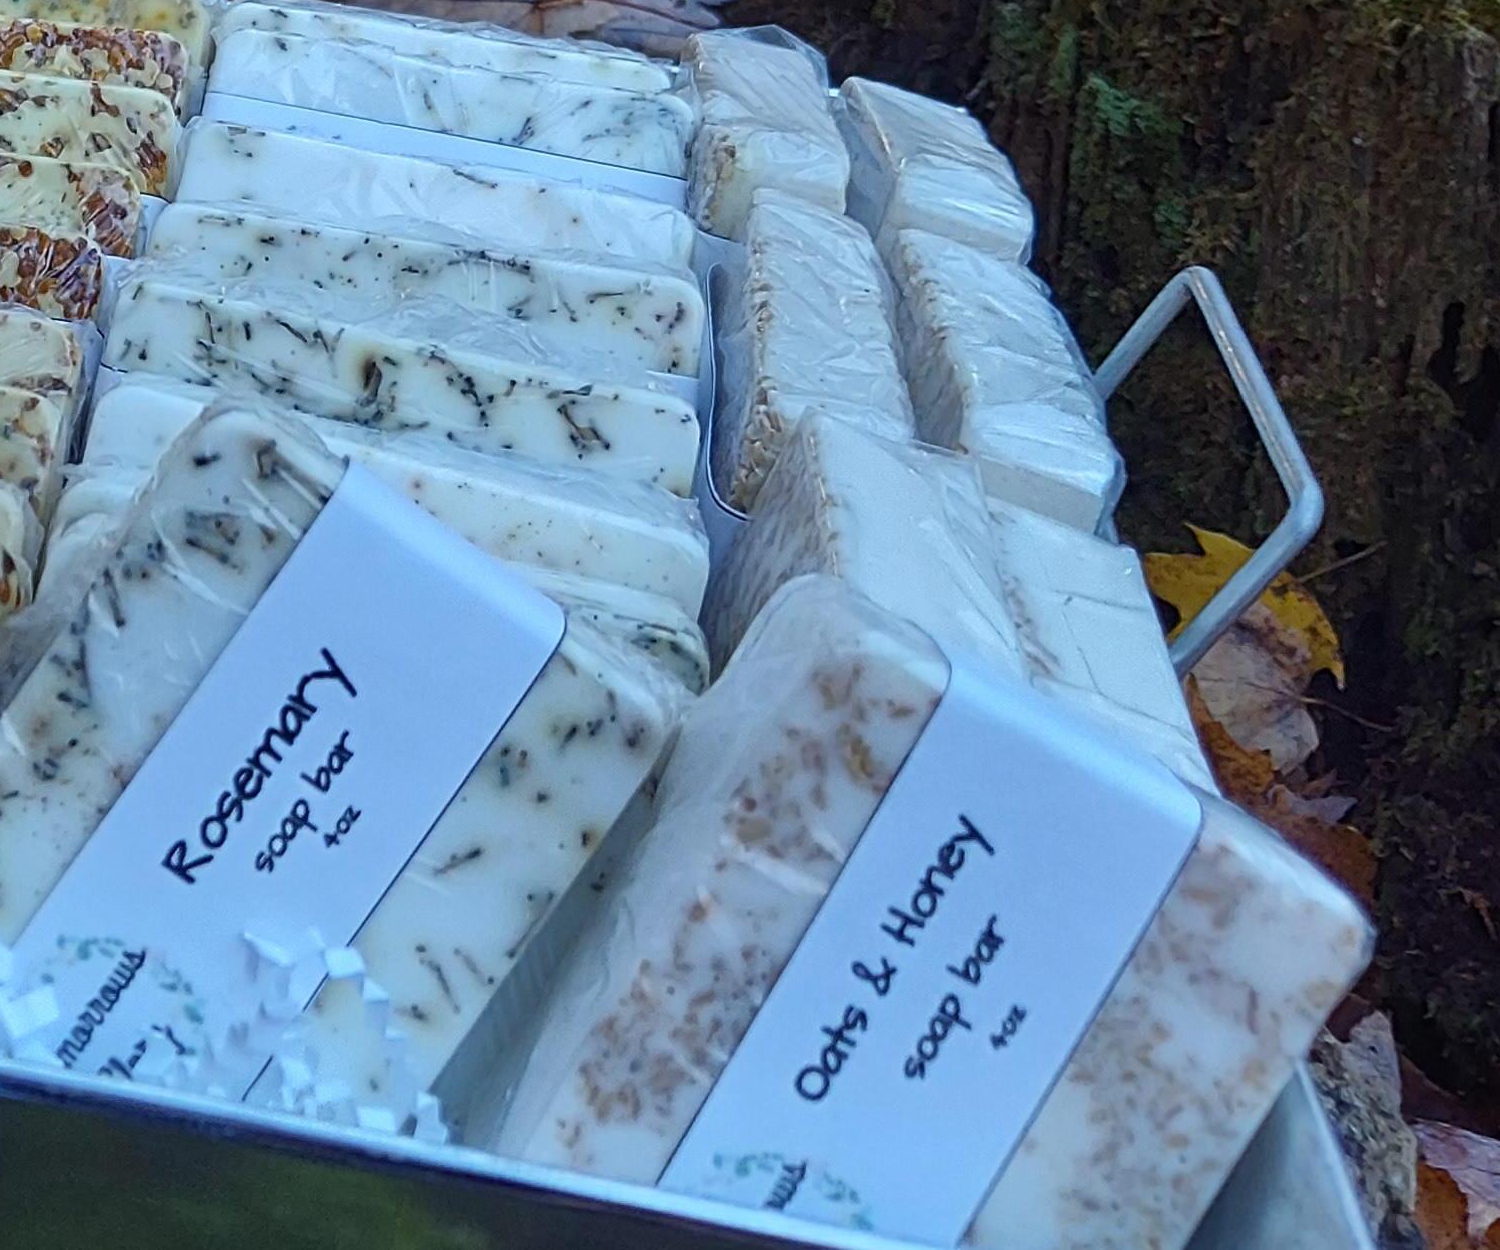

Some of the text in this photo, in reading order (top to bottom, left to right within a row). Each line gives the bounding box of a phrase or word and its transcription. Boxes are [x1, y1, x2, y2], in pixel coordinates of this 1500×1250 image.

[161, 647, 358, 885] Rosemary
[254, 730, 355, 874] soap bar
[323, 804, 362, 849] 4oz
[55, 947, 148, 1070] morrows
[794, 813, 996, 1102] Oats & Honey
[904, 914, 1005, 1081] soap bar
